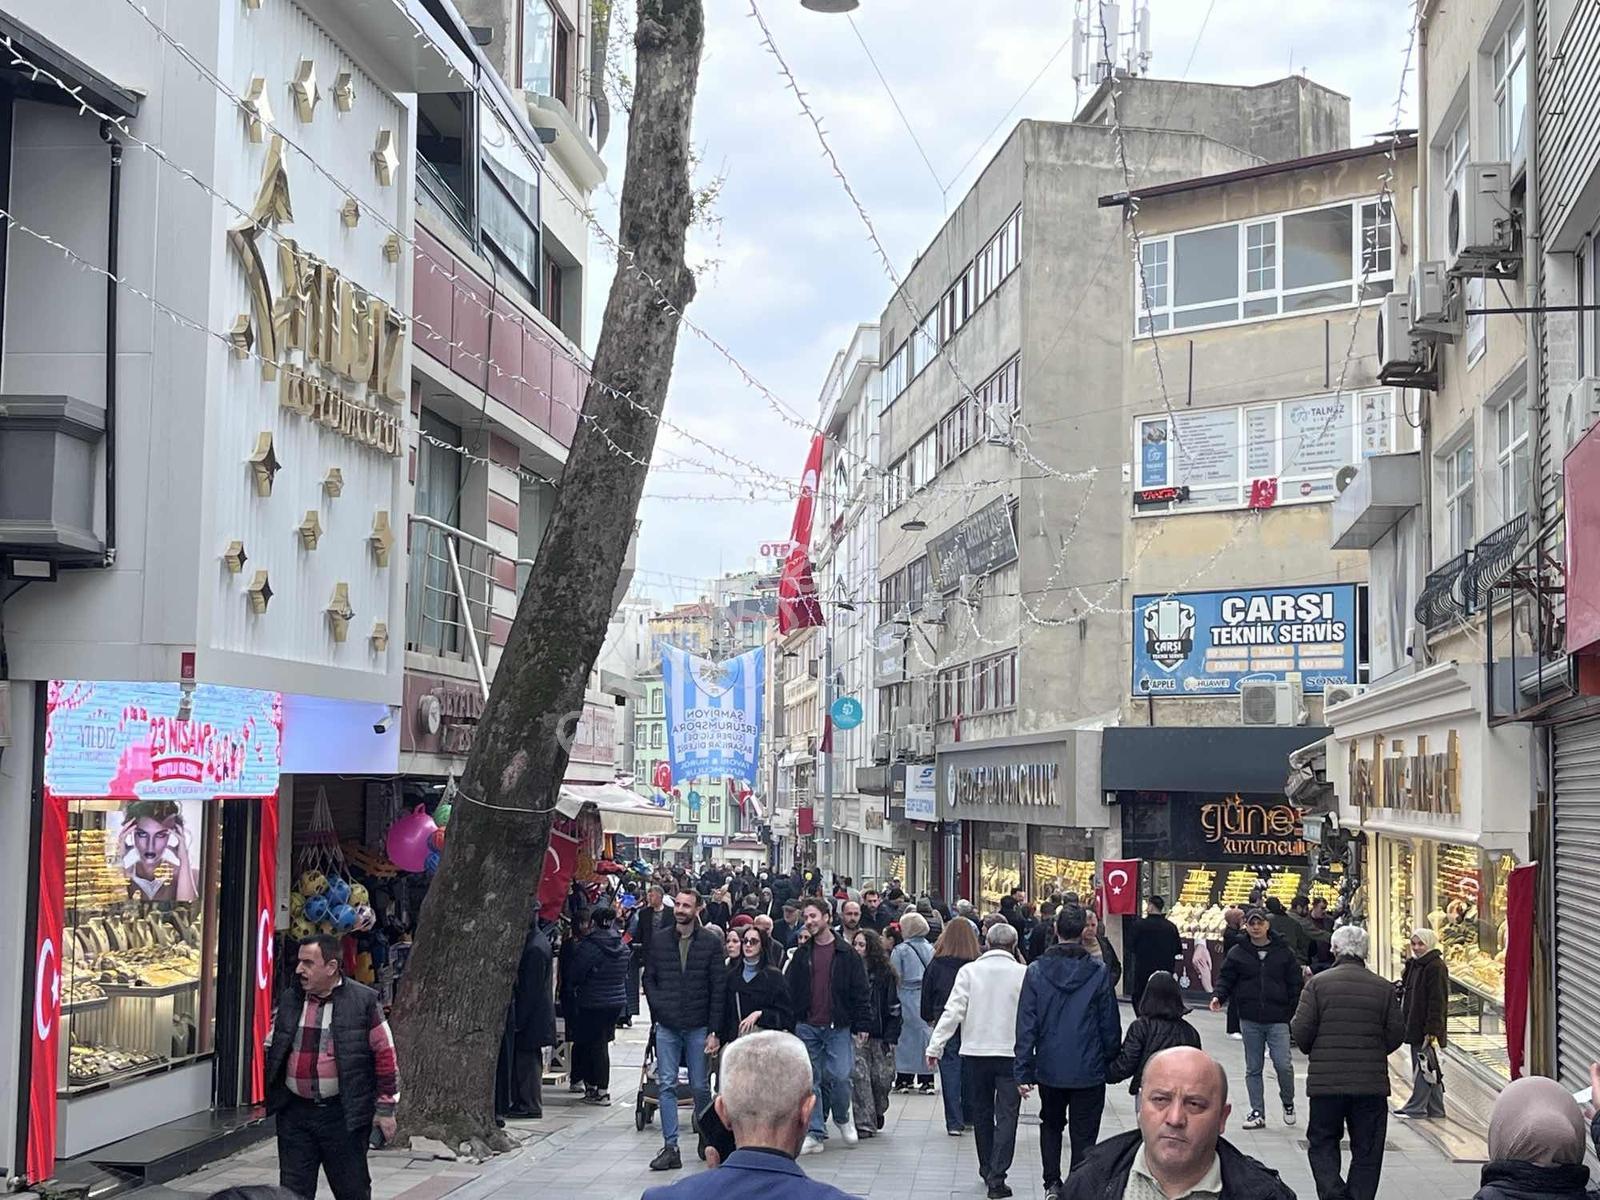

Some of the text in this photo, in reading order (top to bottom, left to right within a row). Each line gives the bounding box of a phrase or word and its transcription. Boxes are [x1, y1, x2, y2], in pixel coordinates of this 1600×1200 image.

[1222, 593, 1333, 626] ÇARŞI
[1211, 620, 1345, 645] TEKNİK SERVİS
[1154, 641, 1182, 653] ÇARŞI
[1152, 680, 1175, 689] APPLE
[1197, 679, 1229, 689] HUAWEI
[1306, 676, 1346, 687] SONY
[79, 724, 117, 750] YILDIZ
[149, 717, 167, 757] 23
